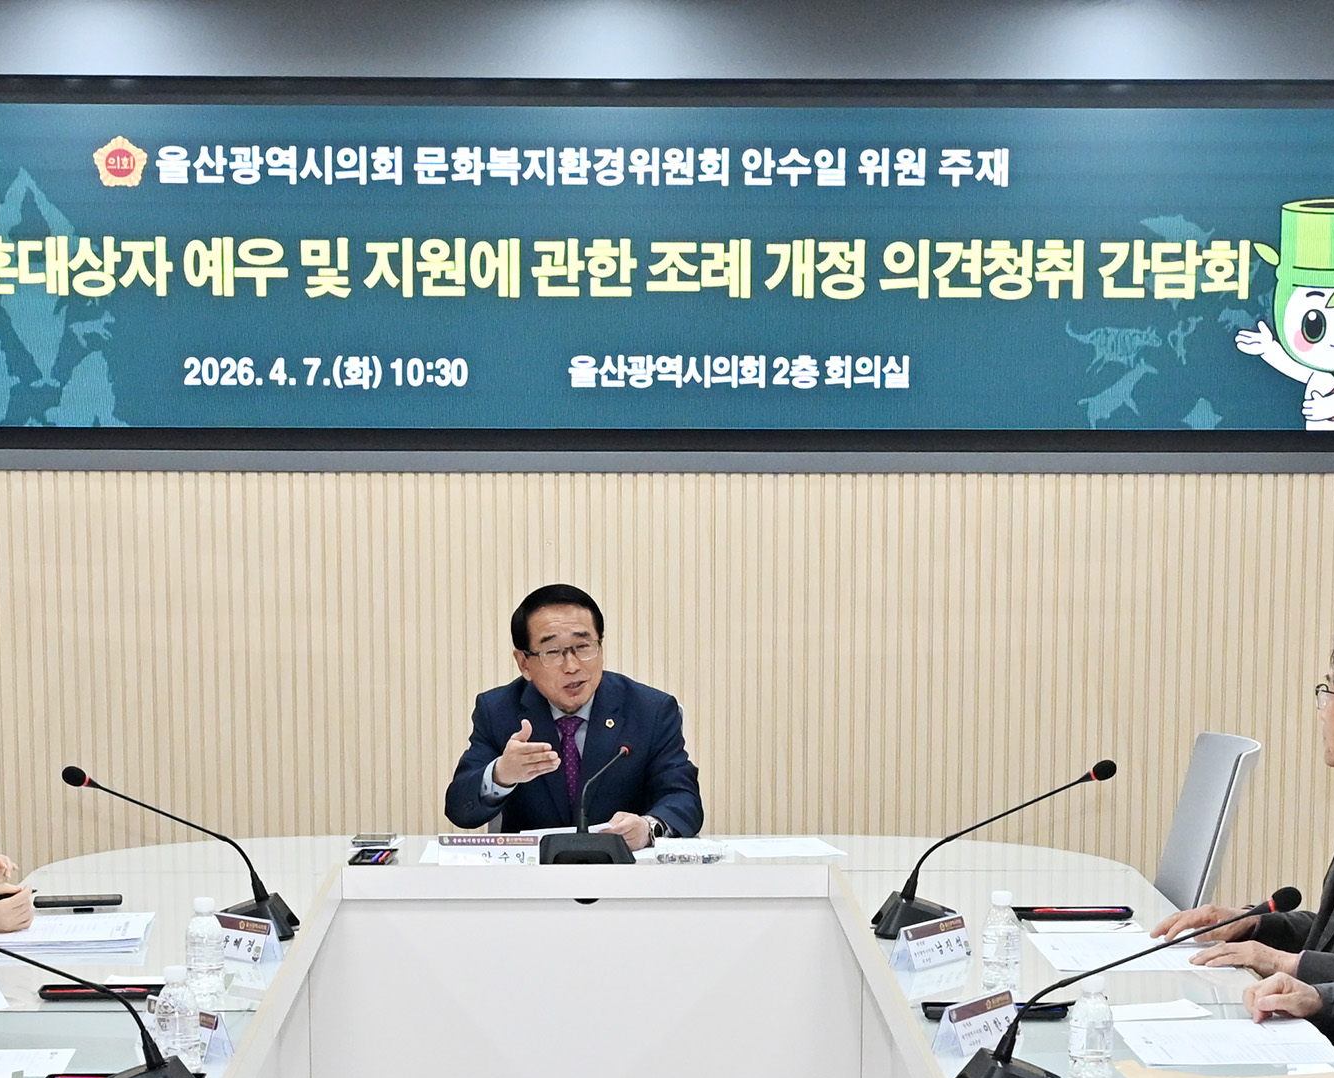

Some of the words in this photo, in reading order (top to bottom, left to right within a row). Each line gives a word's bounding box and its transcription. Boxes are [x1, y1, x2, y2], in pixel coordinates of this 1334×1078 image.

[155, 145, 403, 186] 울산광역시의회
[413, 146, 730, 187] 문화복지환경위원회
[741, 147, 846, 187] 안수일
[858, 147, 926, 187] 위원
[938, 147, 1010, 188] 주재
[183, 236, 289, 298] 예우
[300, 237, 352, 298] 및
[363, 237, 520, 299] 지원에
[531, 238, 638, 298] 관한
[646, 238, 751, 299] 조례
[764, 238, 866, 300] 개정
[879, 239, 1085, 300] 의견청취
[1098, 239, 1252, 300] 간담회
[390, 357, 469, 388] 10:30
[568, 354, 766, 389] 울산광역시의회
[772, 354, 820, 389] 2층
[824, 355, 910, 389] 회의실
